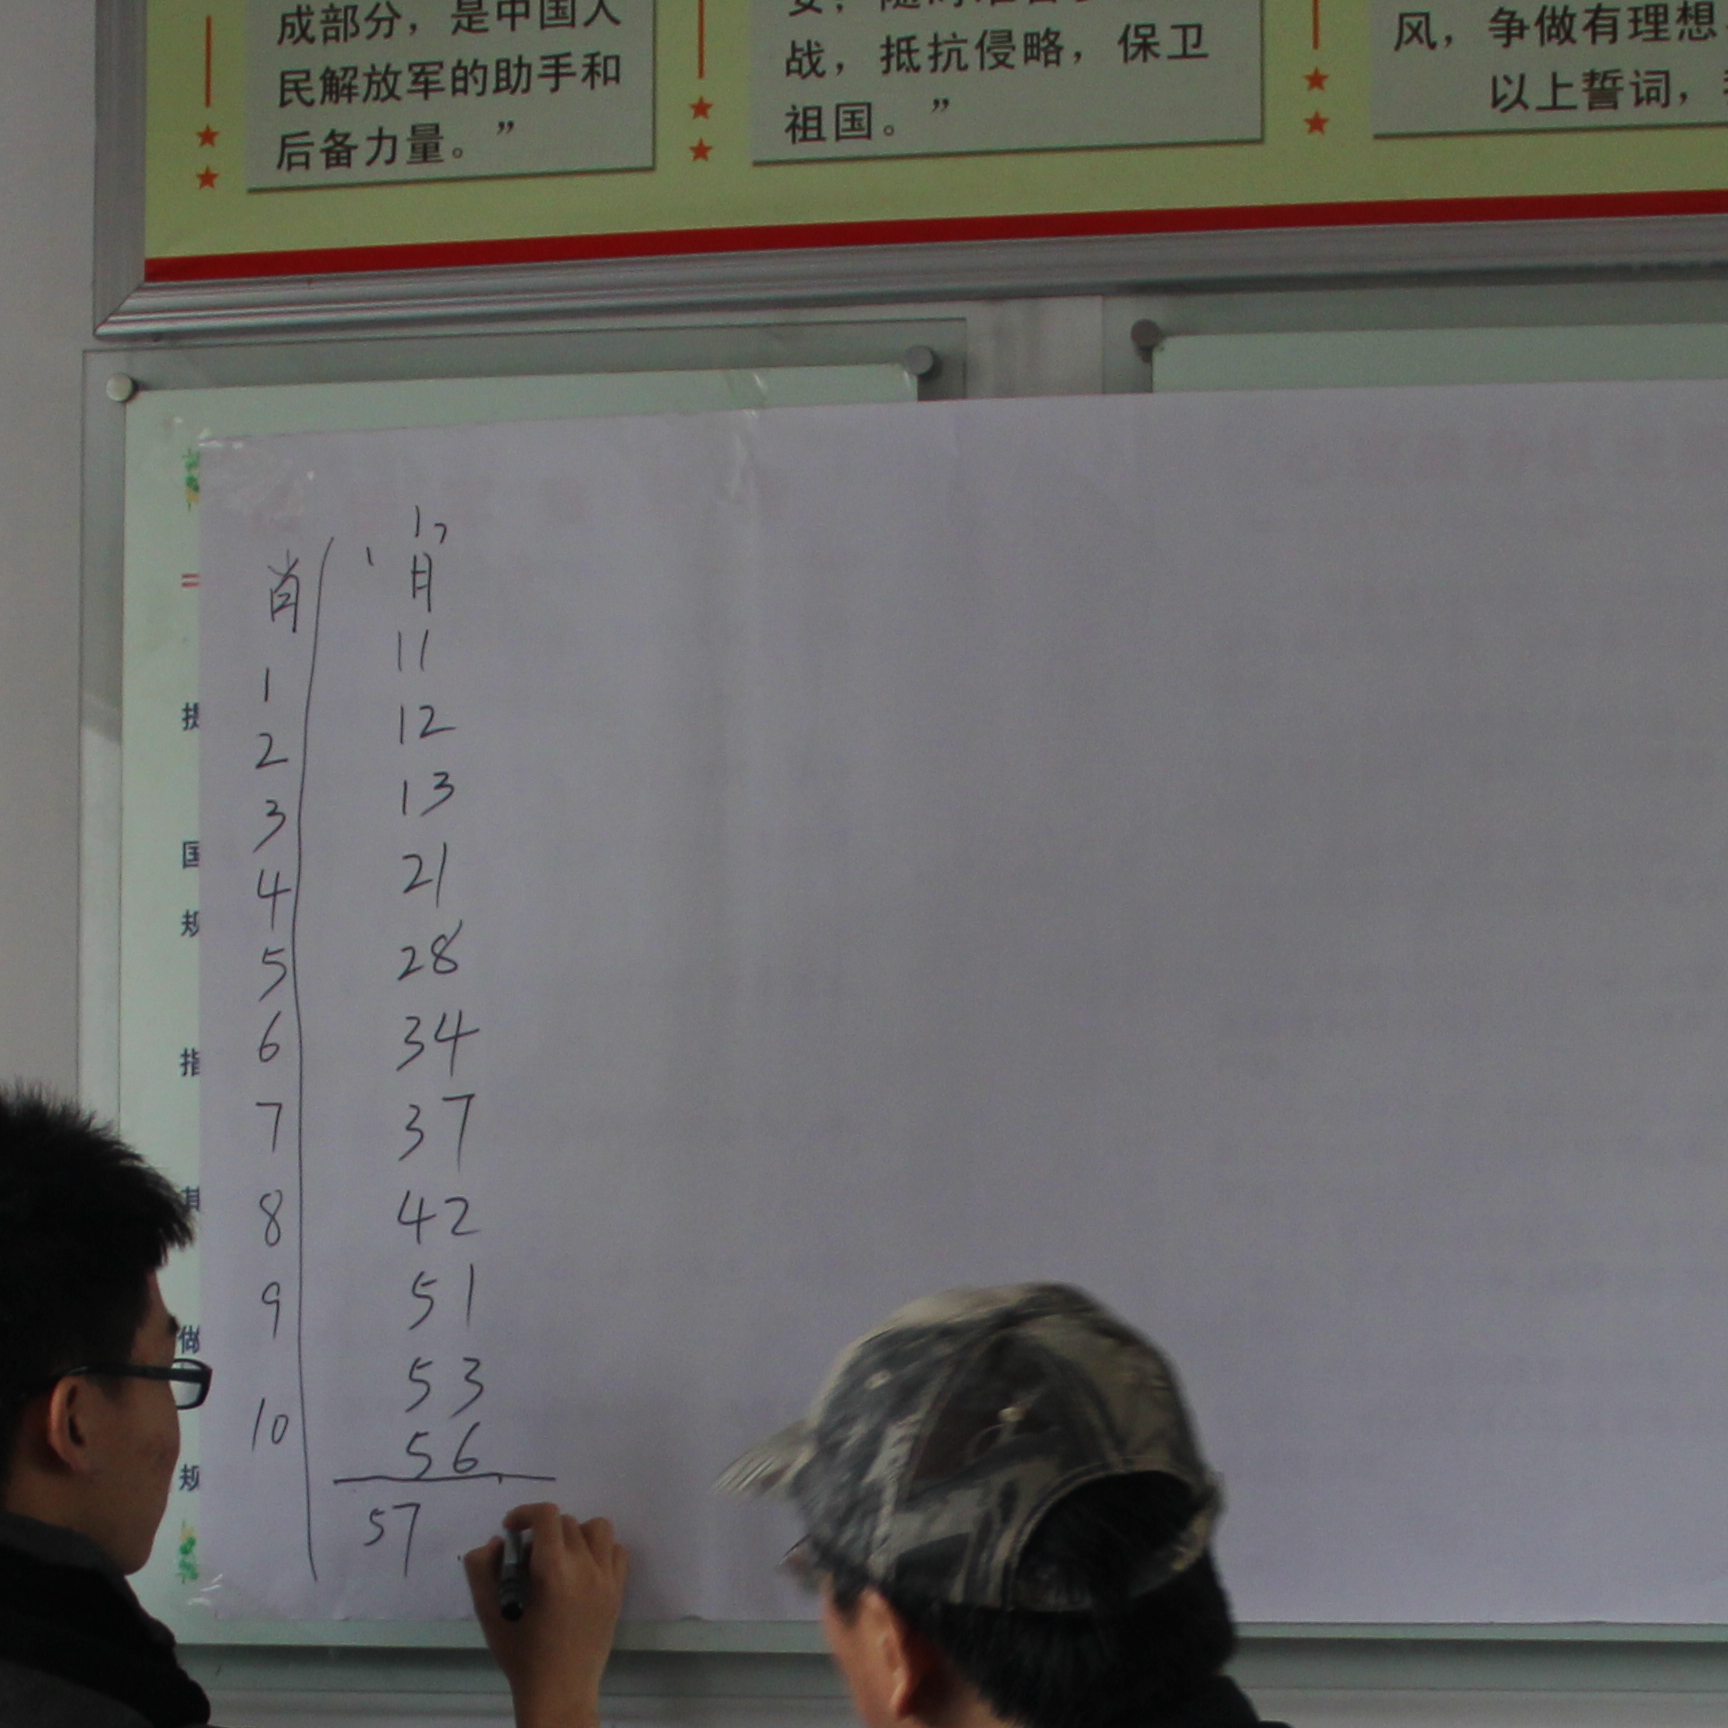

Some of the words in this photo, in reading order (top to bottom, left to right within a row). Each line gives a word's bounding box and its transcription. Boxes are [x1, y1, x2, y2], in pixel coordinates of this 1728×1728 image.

[277, 0, 621, 46] 成部分，是中国人
[786, 23, 1209, 80] 战，抵抗侵略，保卫
[279, 51, 620, 108] 民解放军的助手和
[398, 629, 429, 671] 11
[255, 732, 289, 770] 2
[399, 704, 456, 745] 12
[402, 771, 455, 817] 13
[253, 799, 286, 853] 3
[257, 869, 292, 931] 4
[402, 842, 448, 908] 21
[258, 947, 287, 1002] 5
[397, 919, 463, 982] 28
[258, 1010, 282, 1063] 6
[396, 1009, 480, 1077] 34
[255, 1102, 283, 1153] 7
[398, 1093, 476, 1168] 37
[259, 1189, 283, 1248] 8
[397, 1190, 479, 1245] 42
[261, 1281, 281, 1339] 9
[408, 1263, 475, 1330] 51
[405, 1357, 484, 1418] 53
[252, 1397, 289, 1451] 10
[406, 1421, 480, 1479] 56
[364, 1502, 421, 1577] 57
